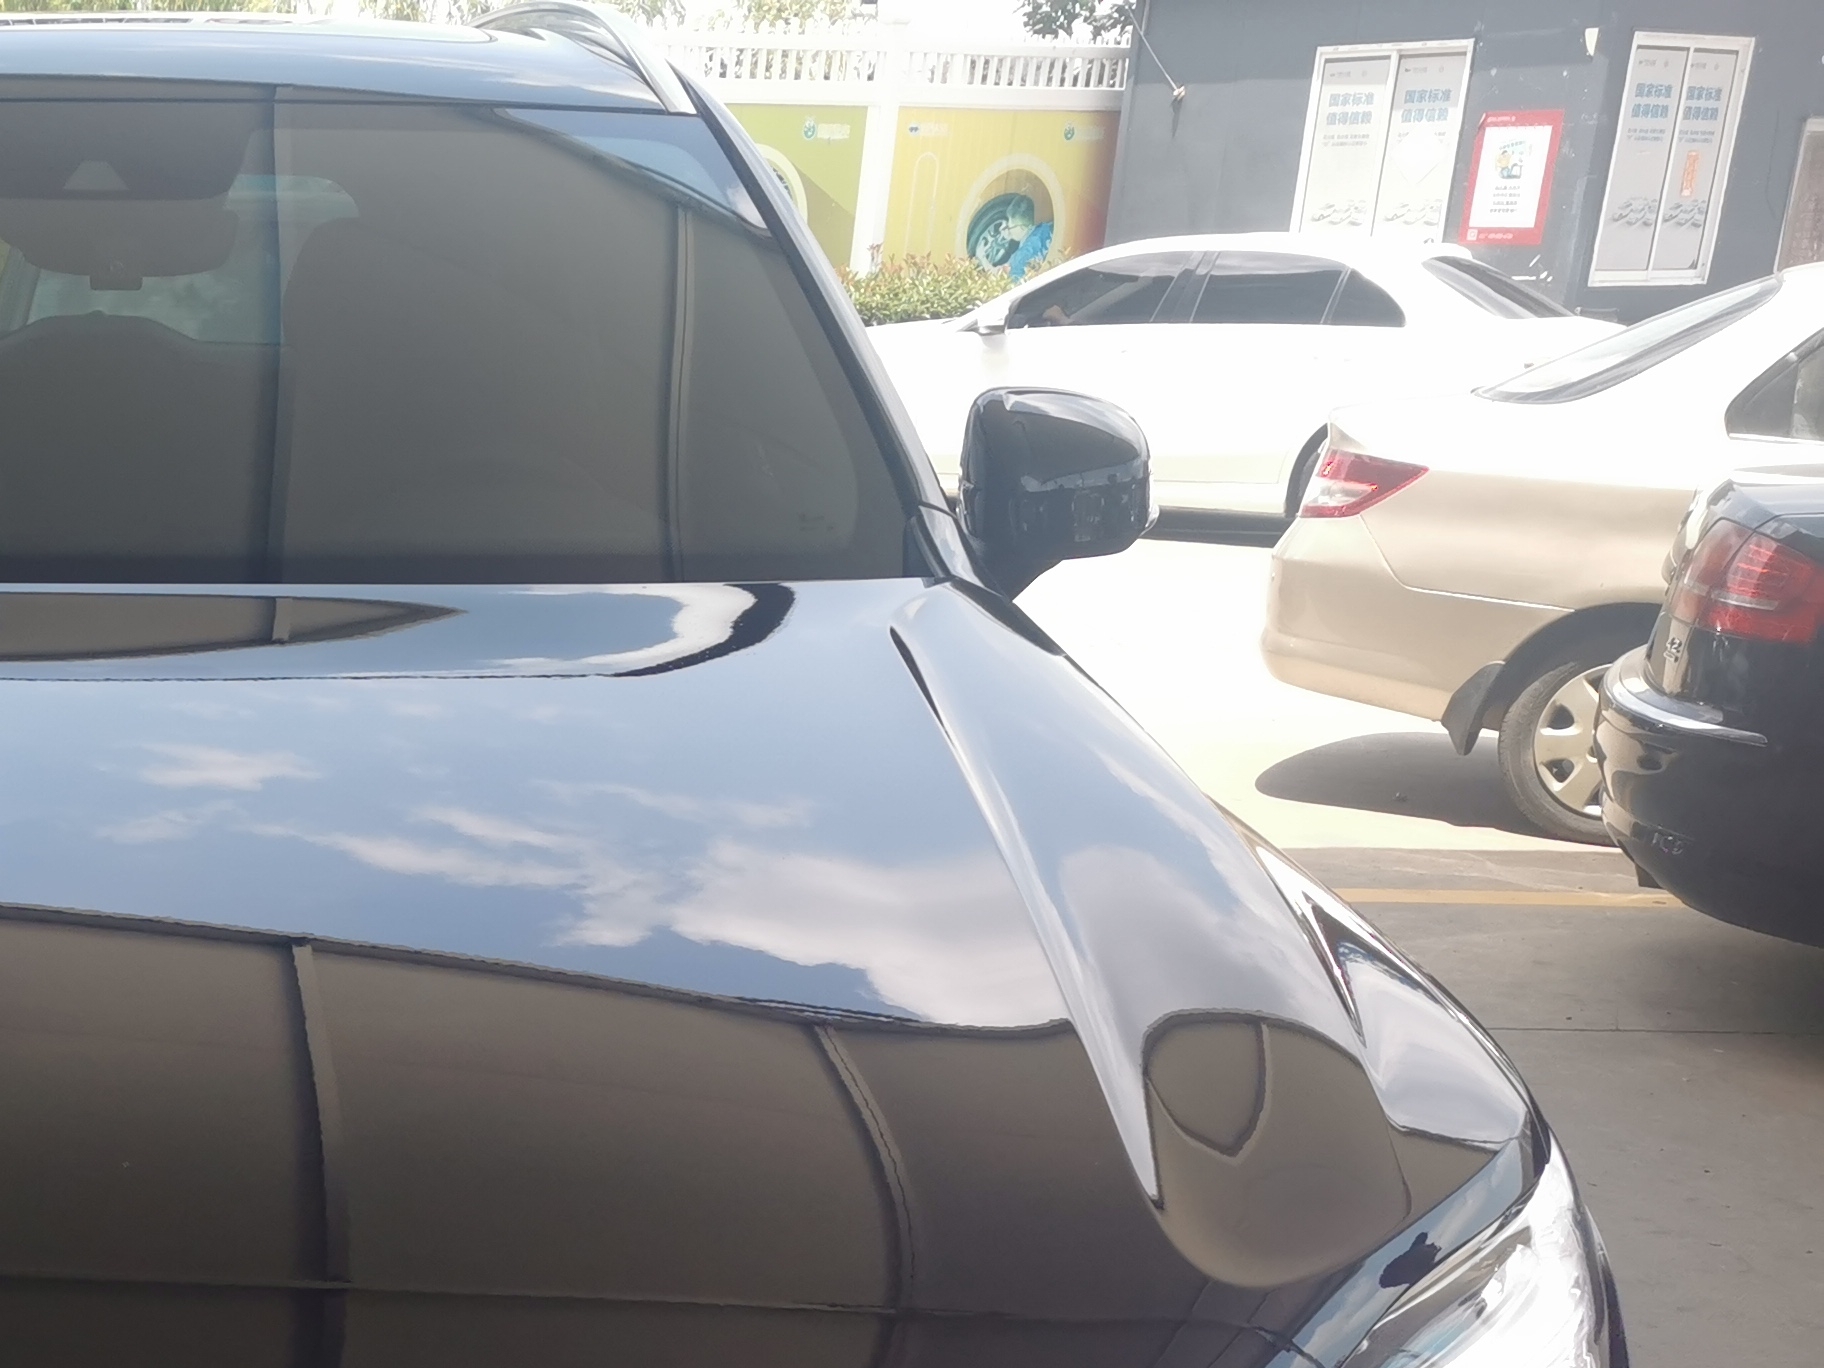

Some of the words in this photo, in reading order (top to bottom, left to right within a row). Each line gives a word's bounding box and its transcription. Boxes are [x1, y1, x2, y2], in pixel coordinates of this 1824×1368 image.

[1328, 91, 1375, 108] 国家标准
[1404, 88, 1453, 105] 国家标准
